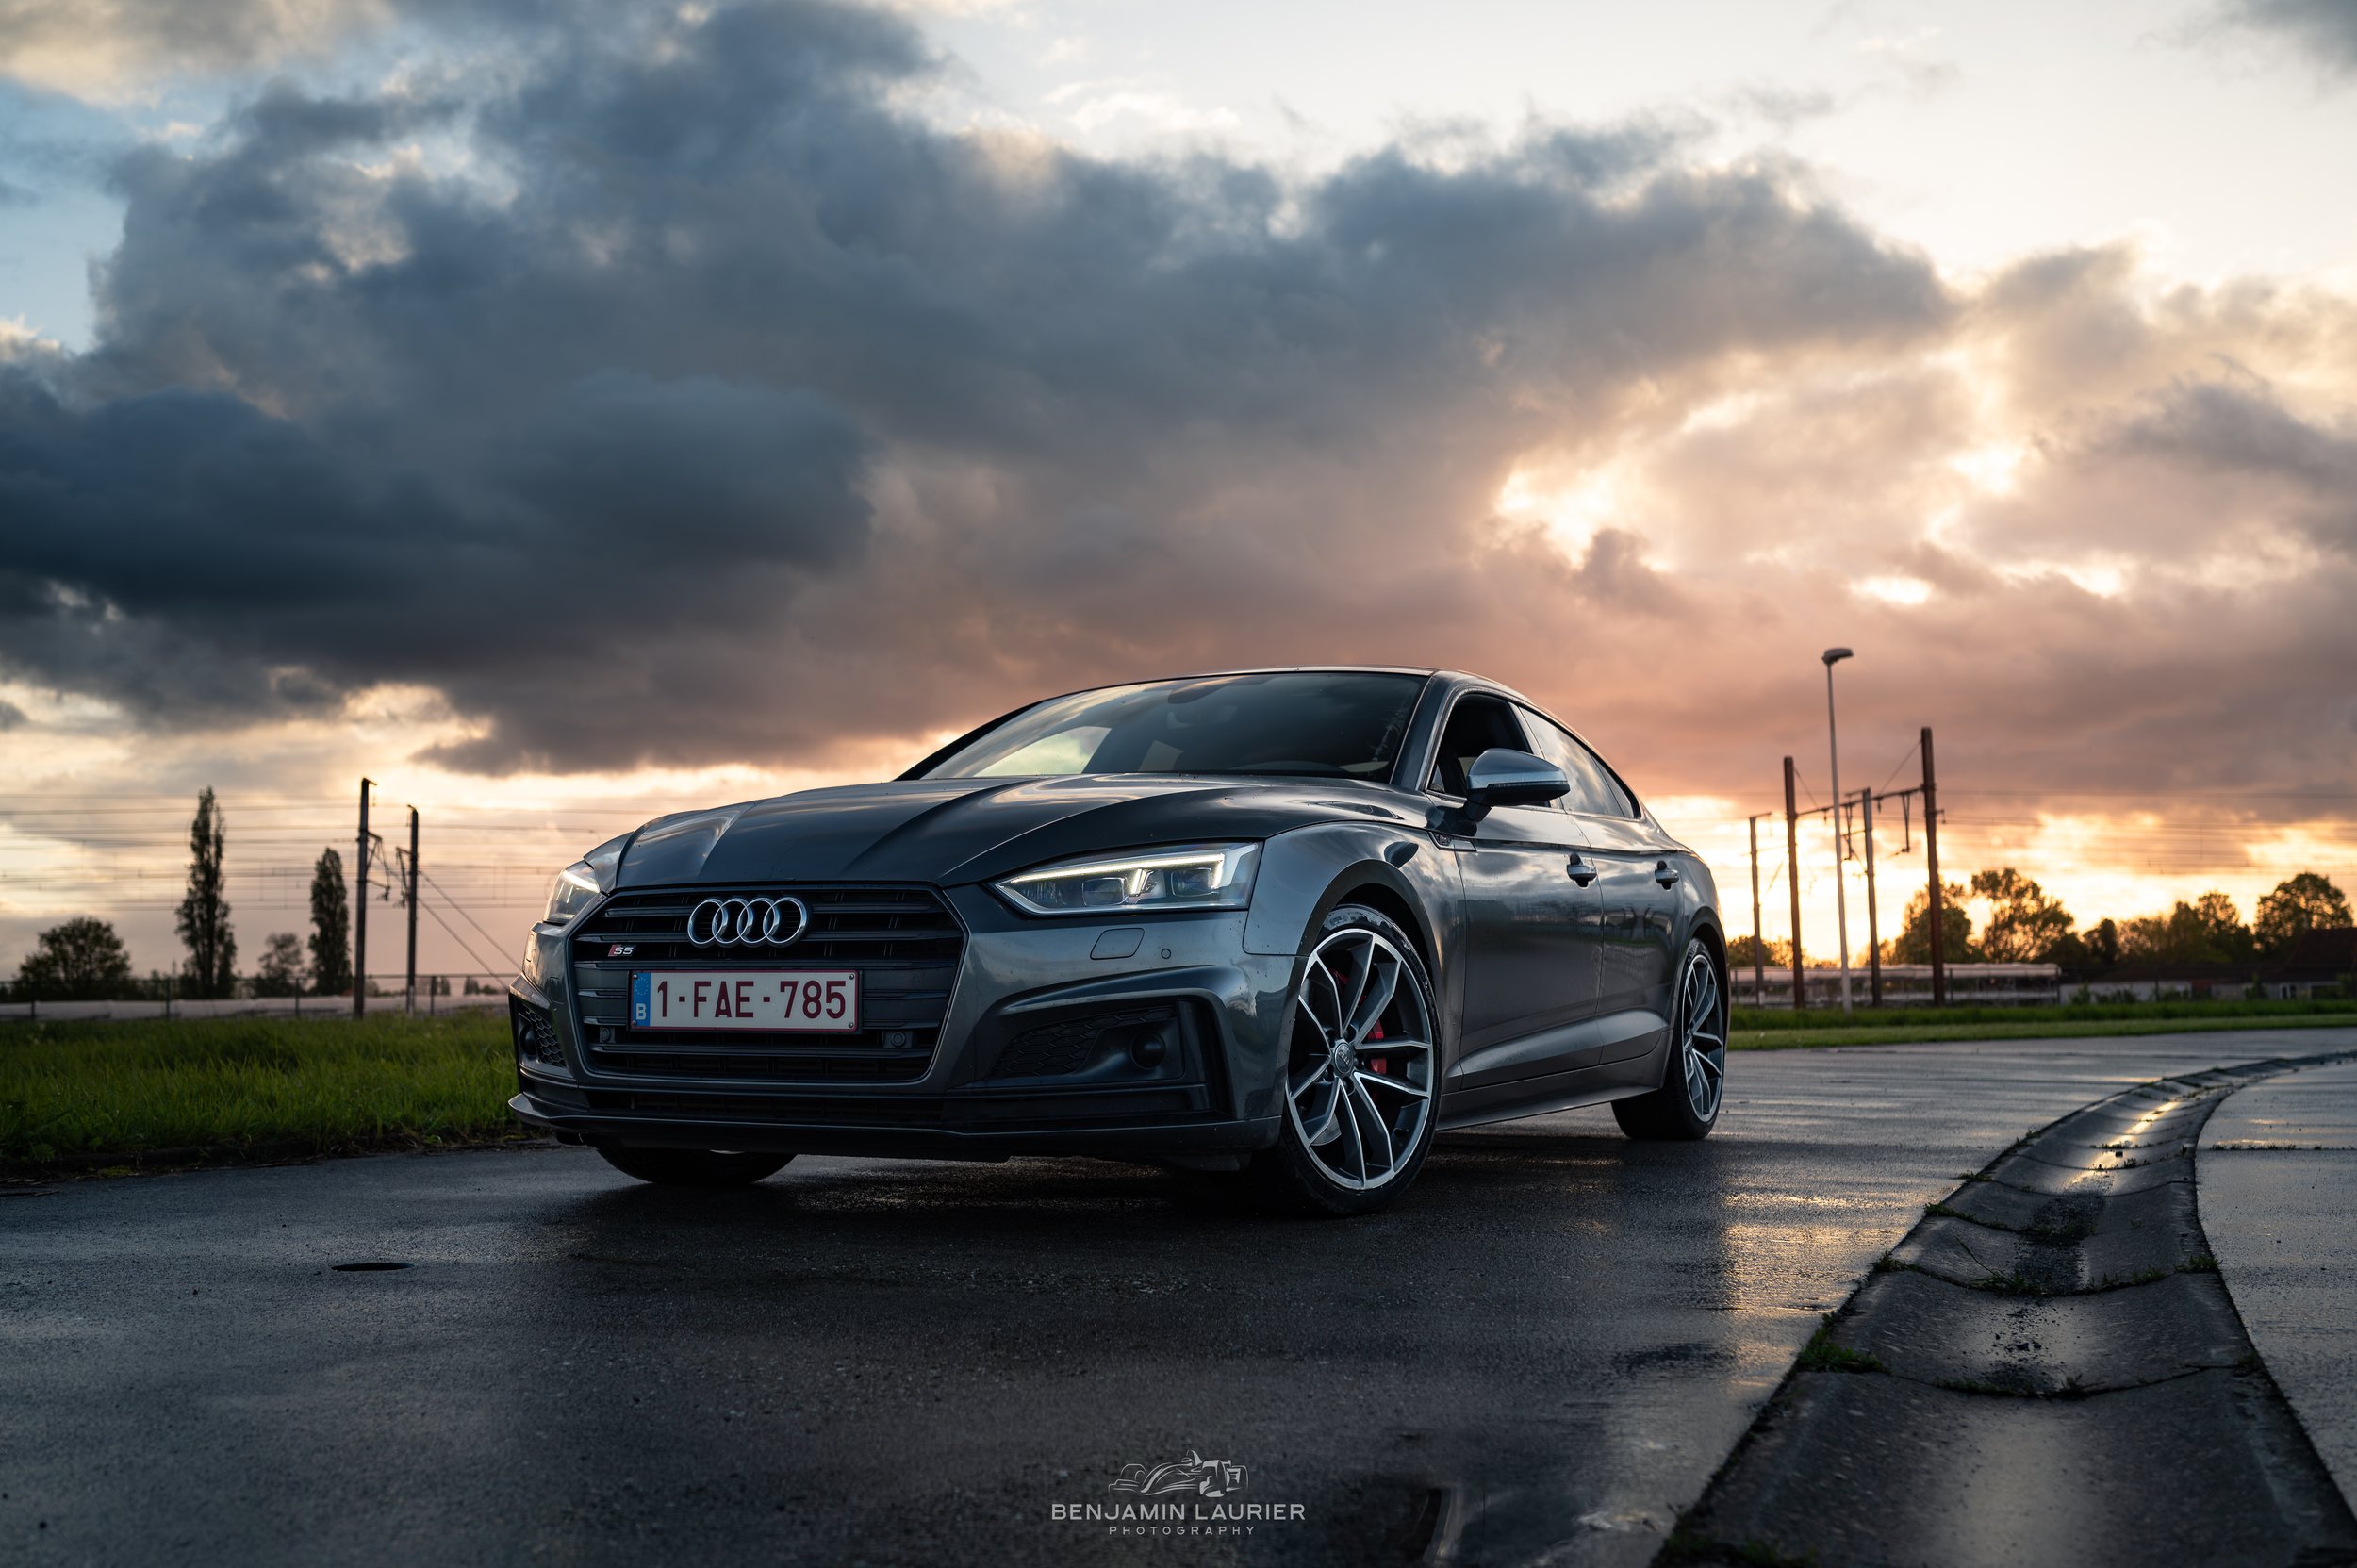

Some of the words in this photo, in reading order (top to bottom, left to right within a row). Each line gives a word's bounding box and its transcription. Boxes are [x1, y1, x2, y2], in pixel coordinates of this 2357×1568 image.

[613, 947, 634, 955] S5
[658, 980, 846, 1019] 1-FAE-785
[635, 1003, 647, 1019] B
